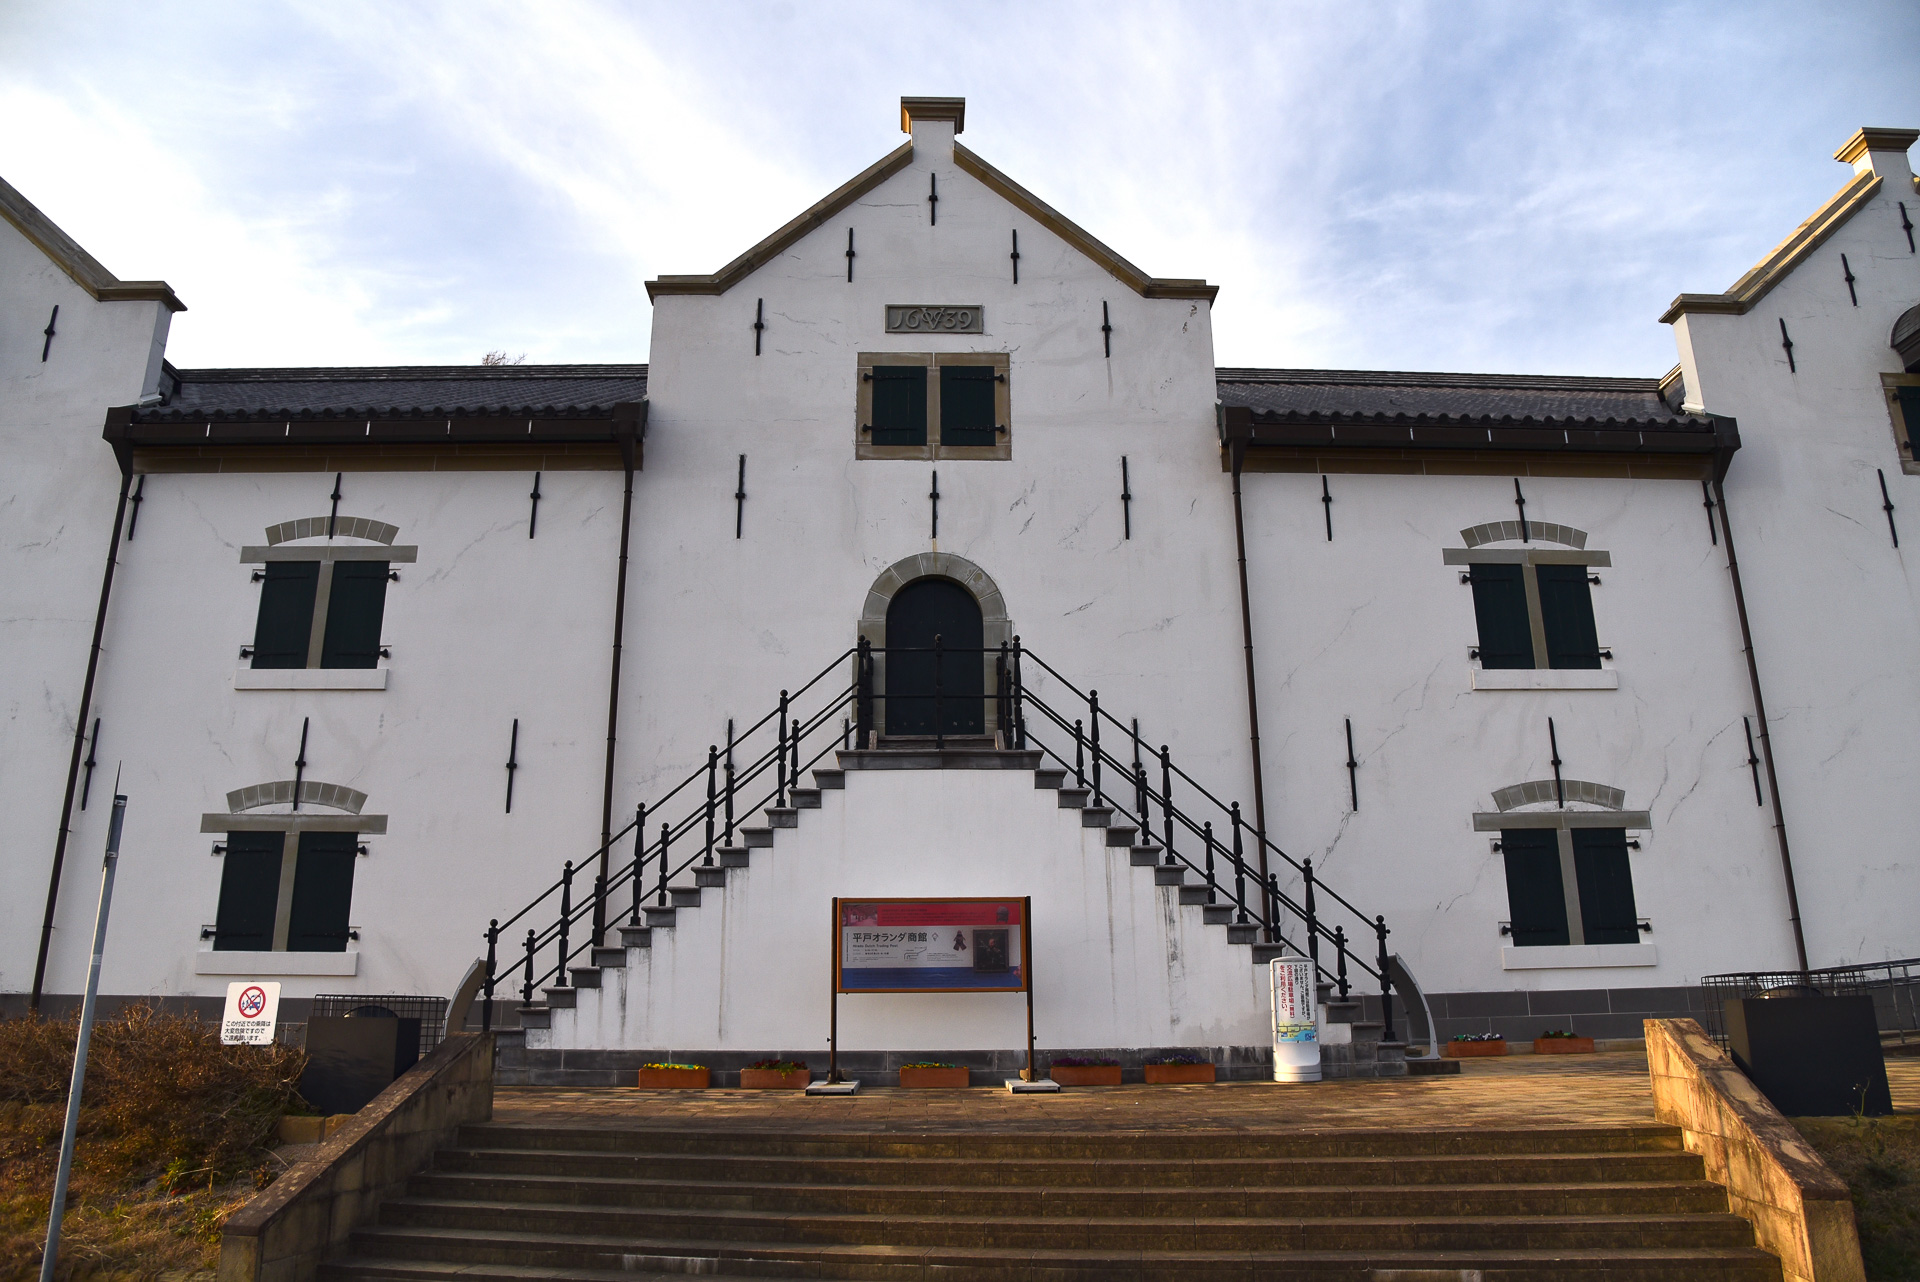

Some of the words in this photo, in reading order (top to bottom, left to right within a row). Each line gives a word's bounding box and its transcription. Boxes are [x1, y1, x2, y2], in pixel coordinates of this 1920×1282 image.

[853, 932, 928, 942] 平戸オランダ商館
